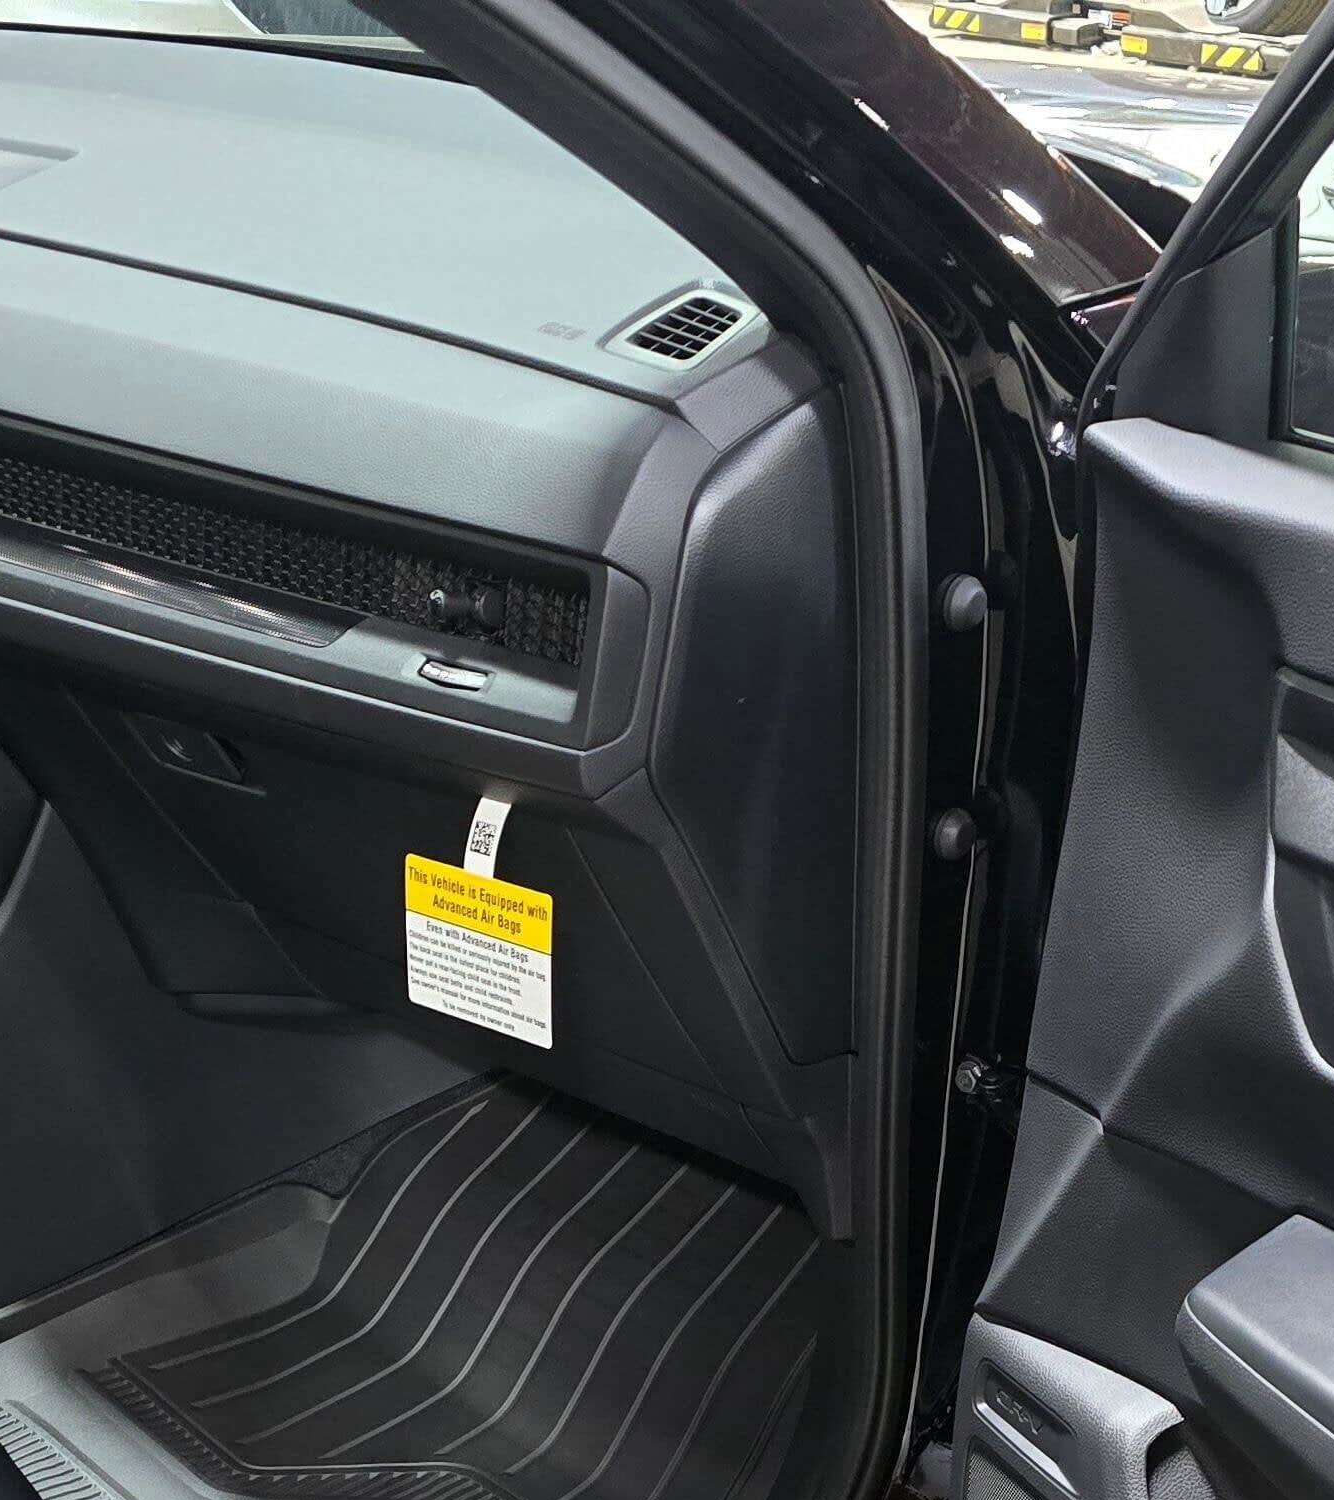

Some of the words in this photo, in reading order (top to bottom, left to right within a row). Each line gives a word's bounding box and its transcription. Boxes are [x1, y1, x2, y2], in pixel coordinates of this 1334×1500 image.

[409, 866, 428, 884] This
[431, 873, 465, 896] Vehicle
[468, 884, 476, 899] is
[479, 888, 524, 914] Equipped
[527, 904, 548, 921] with
[433, 894, 478, 920] Advanced
[481, 910, 494, 924] Air
[498, 914, 521, 934] Bags
[427, 920, 442, 934] Even
[462, 932, 496, 952] Advanced
[499, 944, 508, 955] Air
[511, 948, 529, 963] Bags
